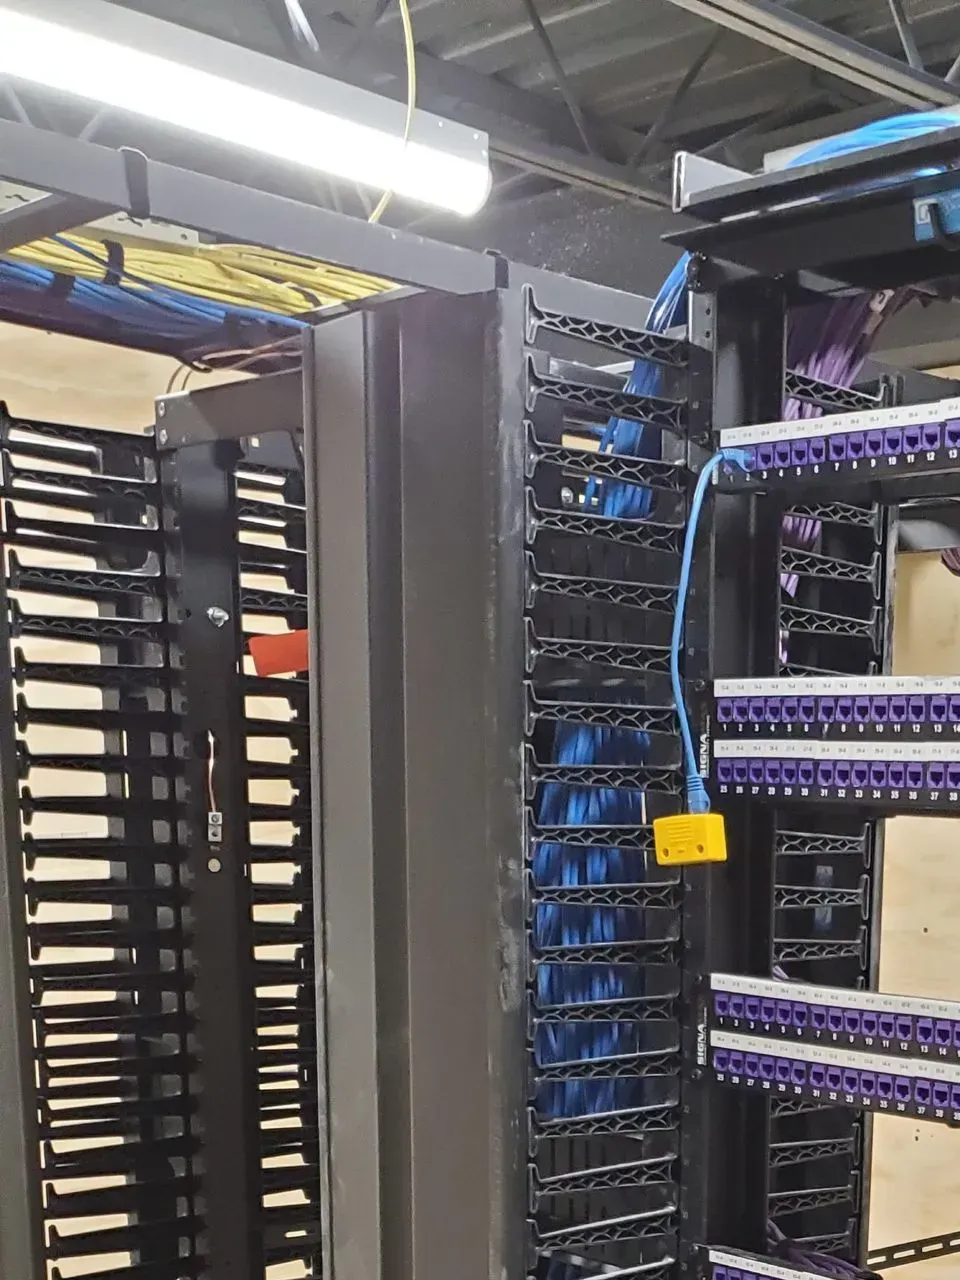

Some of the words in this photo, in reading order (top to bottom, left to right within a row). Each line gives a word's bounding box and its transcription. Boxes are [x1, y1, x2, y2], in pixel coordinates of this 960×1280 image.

[889, 457, 896, 465] 10
[907, 455, 914, 463] 11
[927, 452, 935, 460] 12
[949, 449, 957, 458] 13
[876, 724, 883, 732] 10
[913, 724, 920, 732] 12
[934, 724, 942, 732] 13
[953, 724, 960, 732] 14
[699, 734, 707, 778] SIGNA
[697, 1023, 705, 1065] SIGNA
